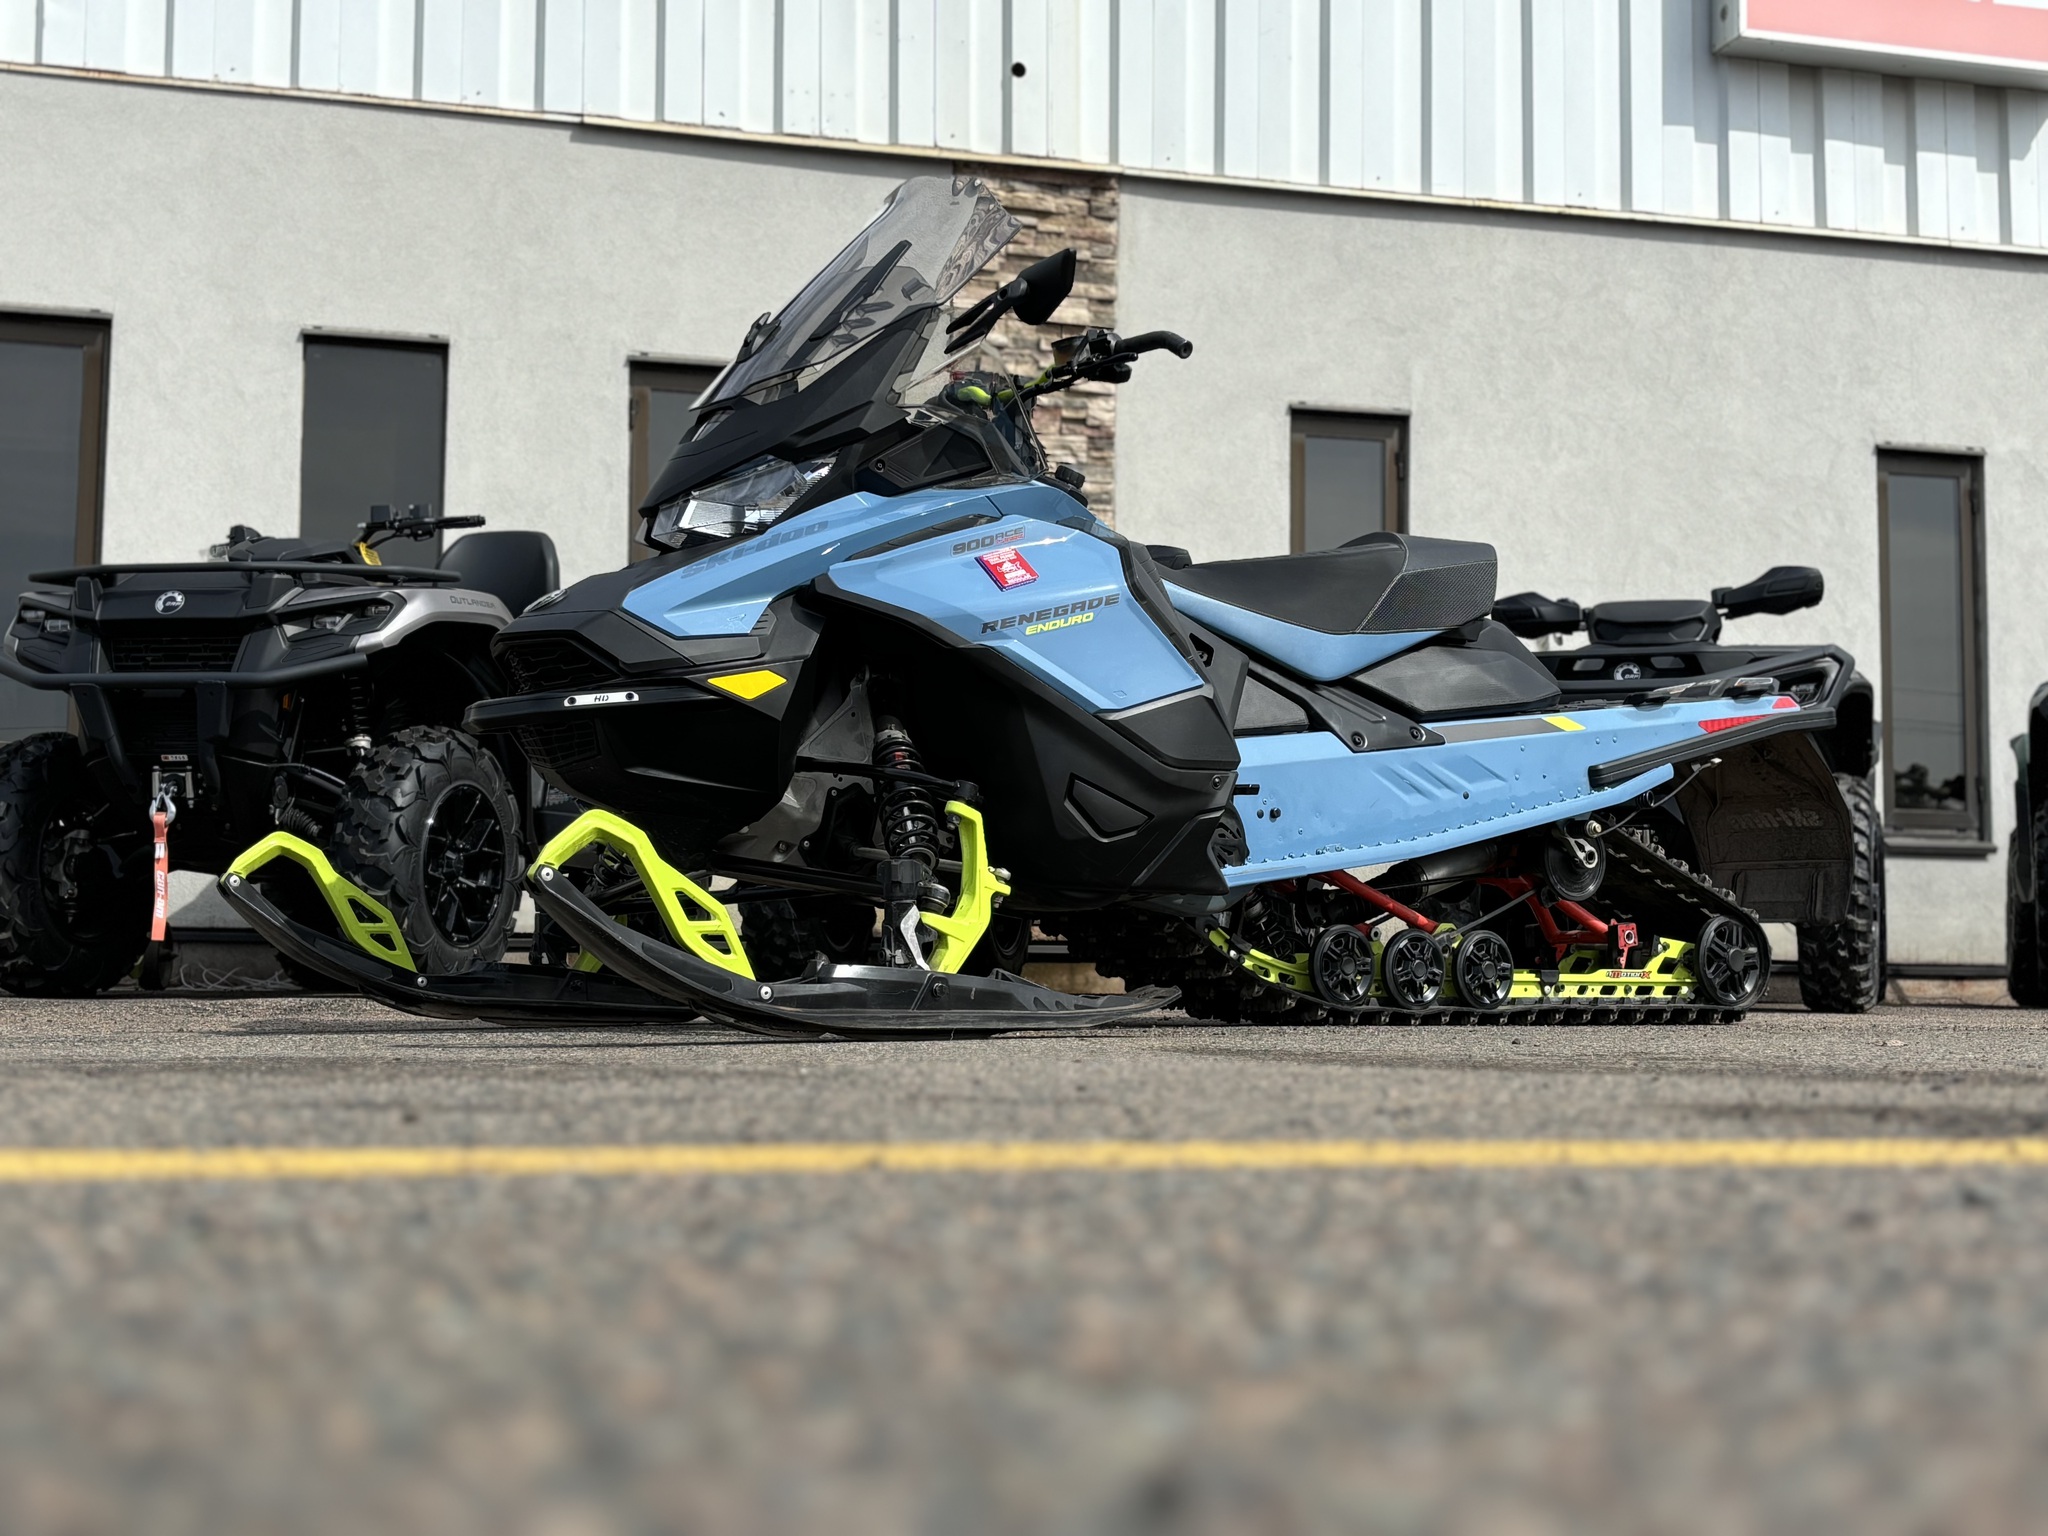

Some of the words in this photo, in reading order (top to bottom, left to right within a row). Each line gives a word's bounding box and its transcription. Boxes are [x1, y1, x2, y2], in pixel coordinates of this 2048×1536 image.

[953, 536, 995, 556] 900
[981, 593, 1120, 634] RENEGADE
[1025, 612, 1094, 635] ENDURO
